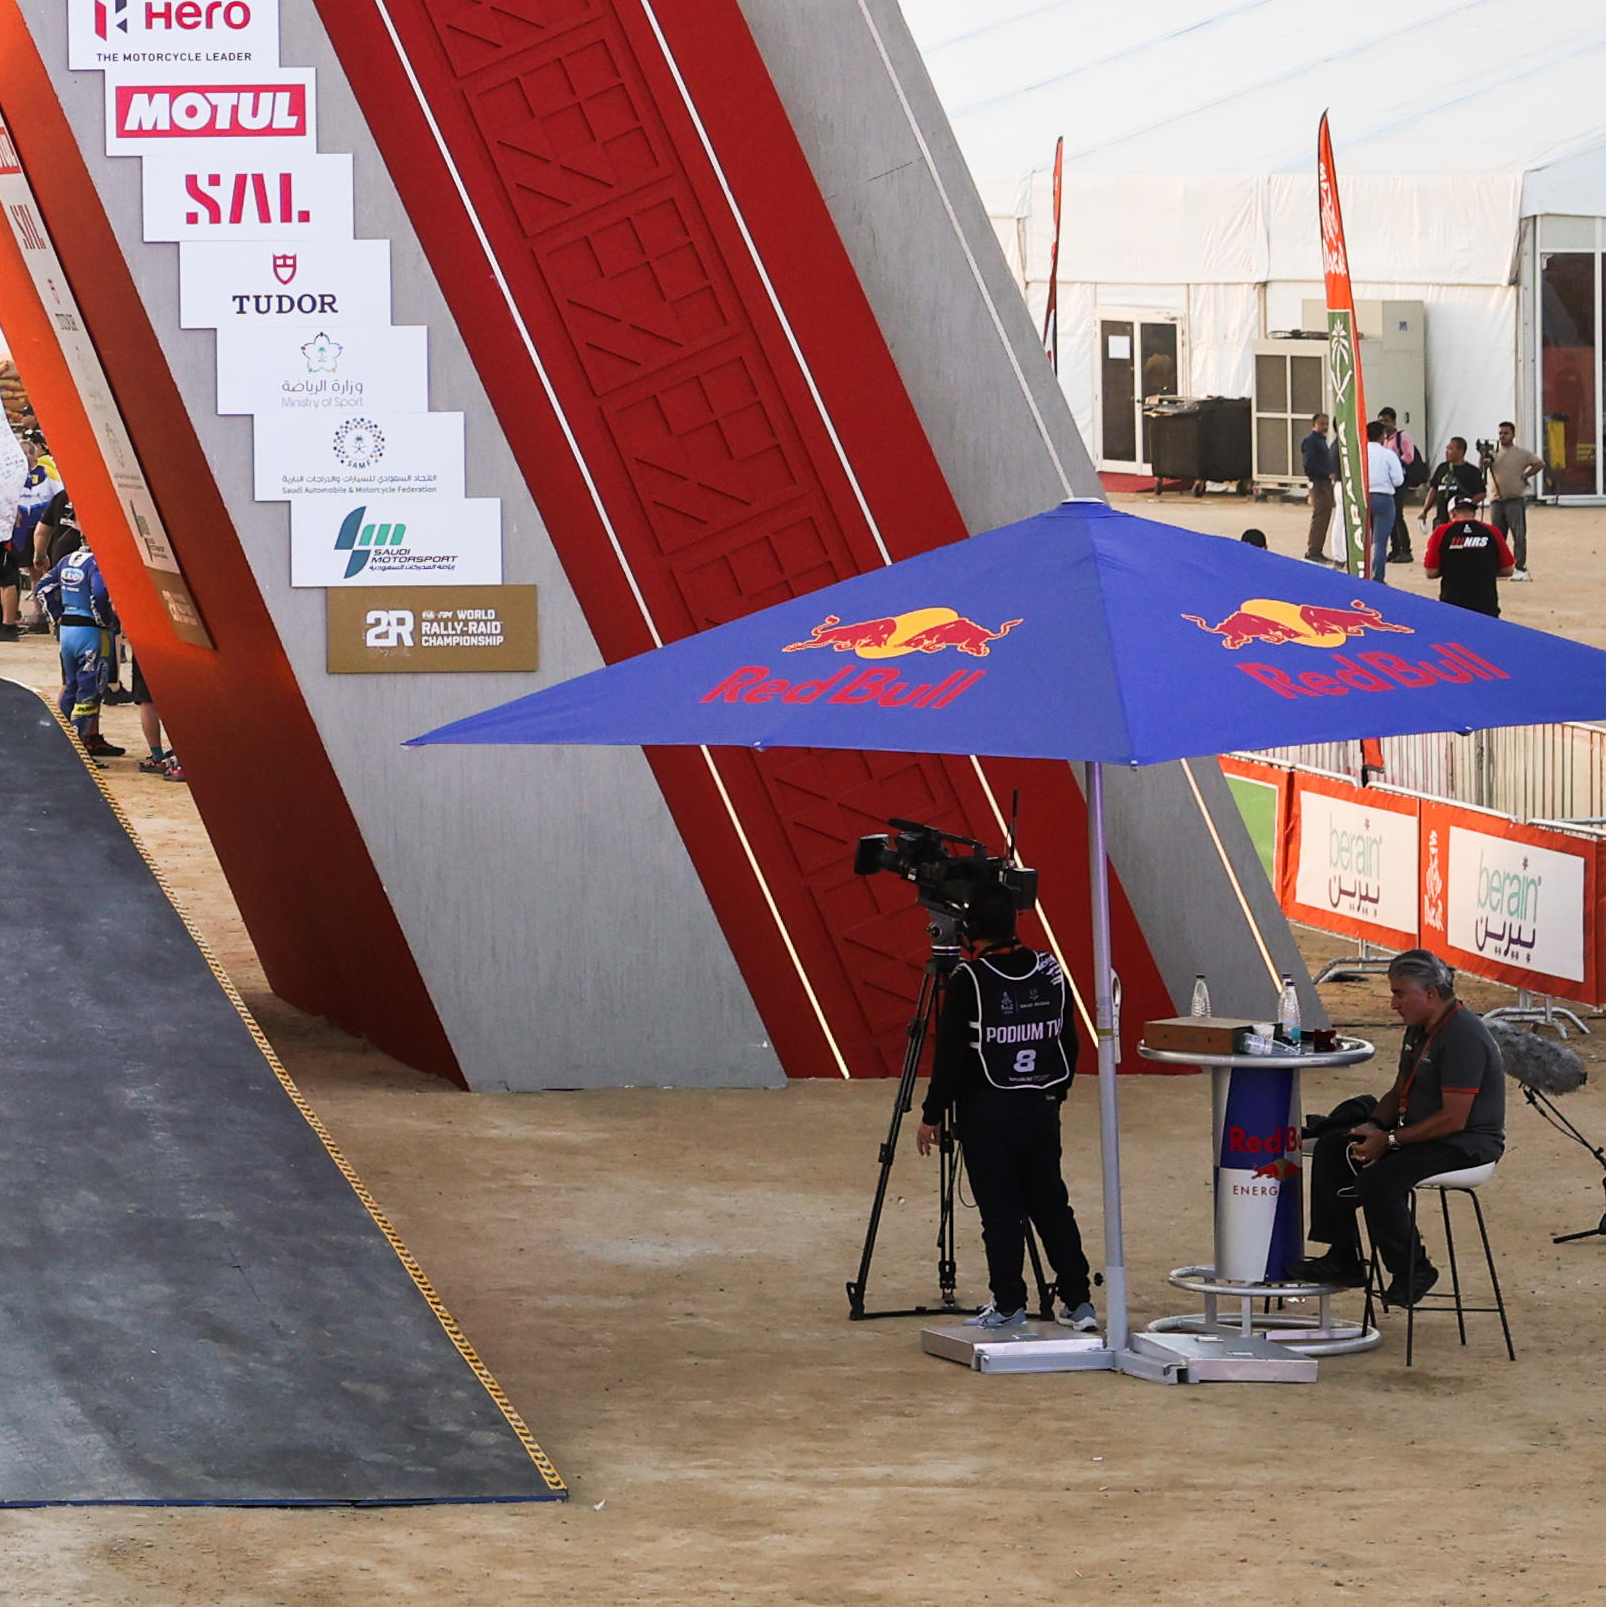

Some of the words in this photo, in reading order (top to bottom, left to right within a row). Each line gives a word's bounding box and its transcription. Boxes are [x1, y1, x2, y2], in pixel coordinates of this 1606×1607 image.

[144, 0, 251, 30] Hero
[96, 53, 119, 62] THE
[123, 52, 202, 62] MOTORCYCLE
[206, 52, 252, 62] LEADER
[123, 91, 299, 131] MOTUL
[232, 293, 339, 315] TUDOR
[281, 379, 327, 395] الرياضة
[331, 379, 364, 395] وزارة
[281, 396, 320, 409] Ministry
[321, 396, 333, 407] of
[334, 396, 364, 409] Sport
[282, 486, 303, 494] Saudi
[304, 486, 347, 494] Automobile
[355, 486, 396, 495] Motorcycle
[397, 486, 437, 494] Federation
[374, 548, 411, 556] SAUDI
[1463, 536, 1489, 548] NRS
[370, 555, 458, 563] MOTORSPORT
[456, 609, 495, 620] WORLD
[421, 621, 501, 635] RALLY-RAID
[421, 635, 504, 647] CHAMPIONSHIP
[1235, 652, 1371, 700] Red
[1359, 642, 1511, 690] Bull
[700, 665, 853, 705] Red
[832, 667, 987, 709] Bull
[1328, 812, 1381, 879] berain
[1328, 874, 1380, 917] بيرين
[1477, 850, 1539, 923] berain
[1475, 915, 1537, 963] بيرين
[986, 1022, 1044, 1044] PODIUM
[1046, 1018, 1061, 1040] TV
[1013, 1049, 1037, 1073] 8
[1228, 1126, 1282, 1153] Red
